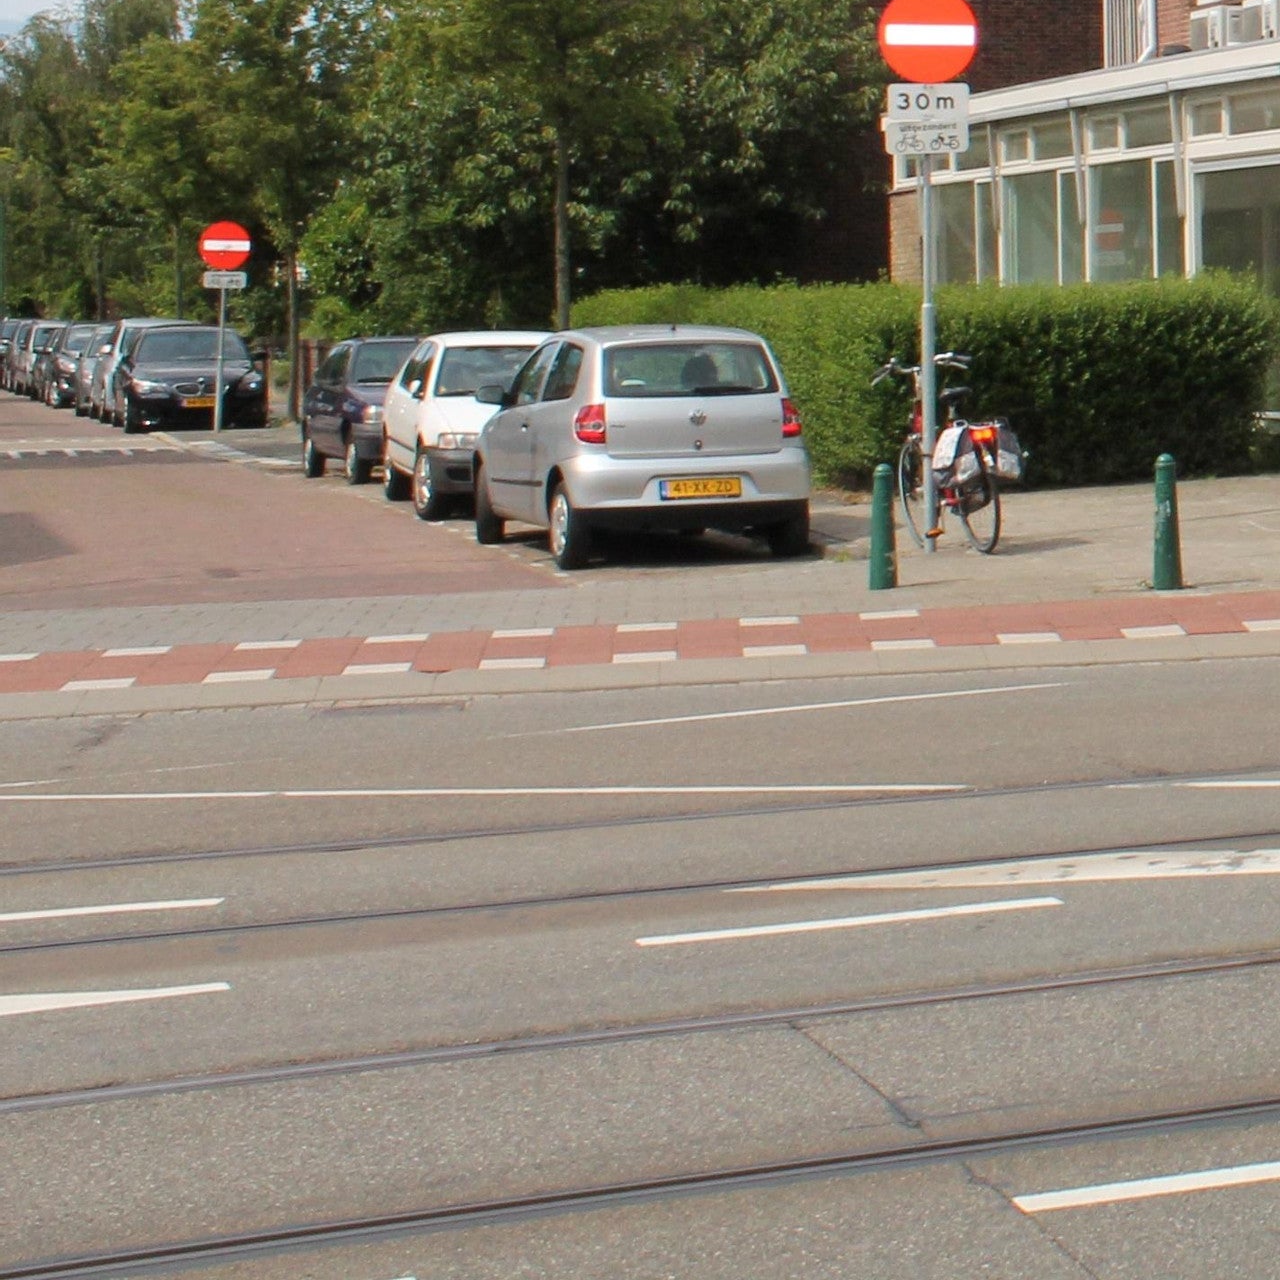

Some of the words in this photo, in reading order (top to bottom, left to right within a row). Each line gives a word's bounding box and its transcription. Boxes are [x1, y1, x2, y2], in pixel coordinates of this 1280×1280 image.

[897, 93, 930, 110] 30
[936, 95, 954, 109] m
[672, 481, 733, 494] 41-XK-ZD
